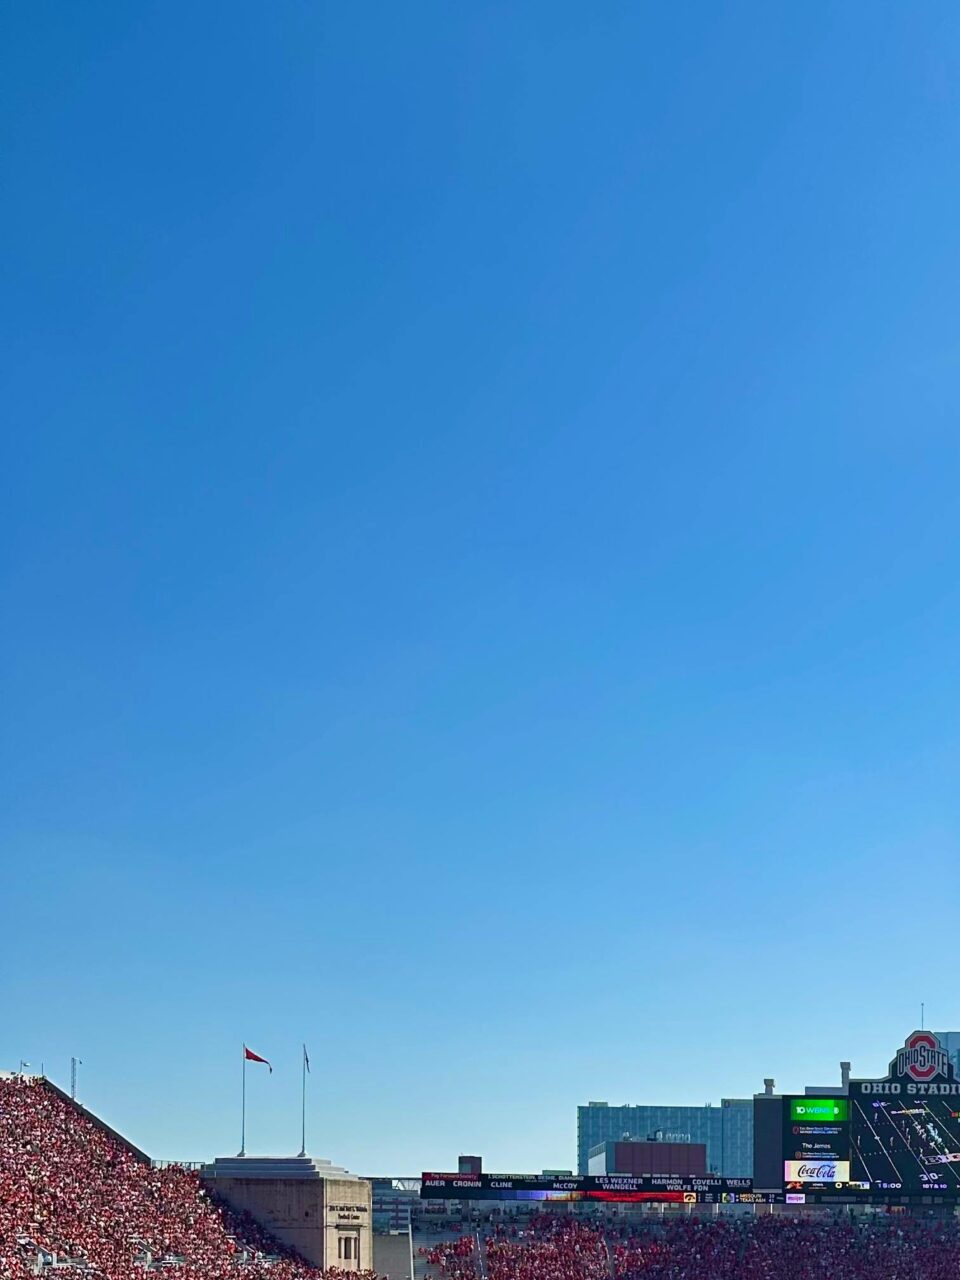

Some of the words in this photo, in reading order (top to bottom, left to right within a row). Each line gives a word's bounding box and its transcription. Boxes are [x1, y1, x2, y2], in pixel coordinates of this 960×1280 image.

[898, 1049, 918, 1077] OHIO
[919, 1046, 947, 1077] STATE
[861, 1083, 901, 1094] OHIO
[595, 1177, 609, 1185] LES
